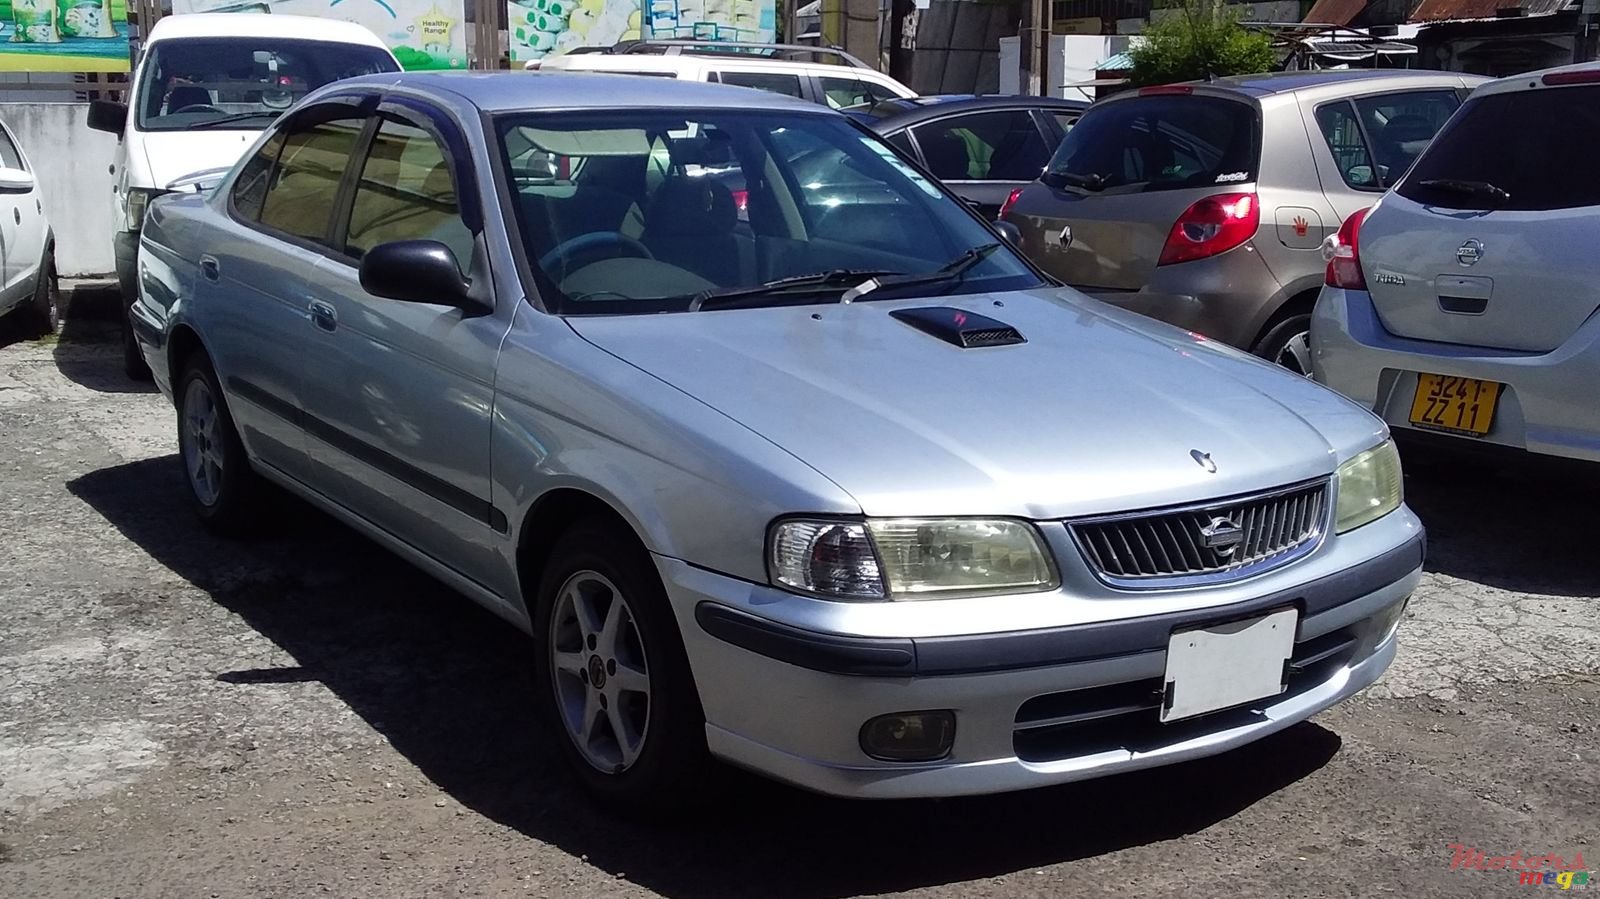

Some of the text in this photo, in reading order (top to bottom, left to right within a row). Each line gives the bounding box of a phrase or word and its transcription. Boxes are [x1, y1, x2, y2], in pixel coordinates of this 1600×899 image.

[422, 20, 449, 28] Healthy
[424, 27, 447, 35] Range
[1431, 376, 1482, 402] 3241
[1422, 397, 1480, 429] ZZ 11
